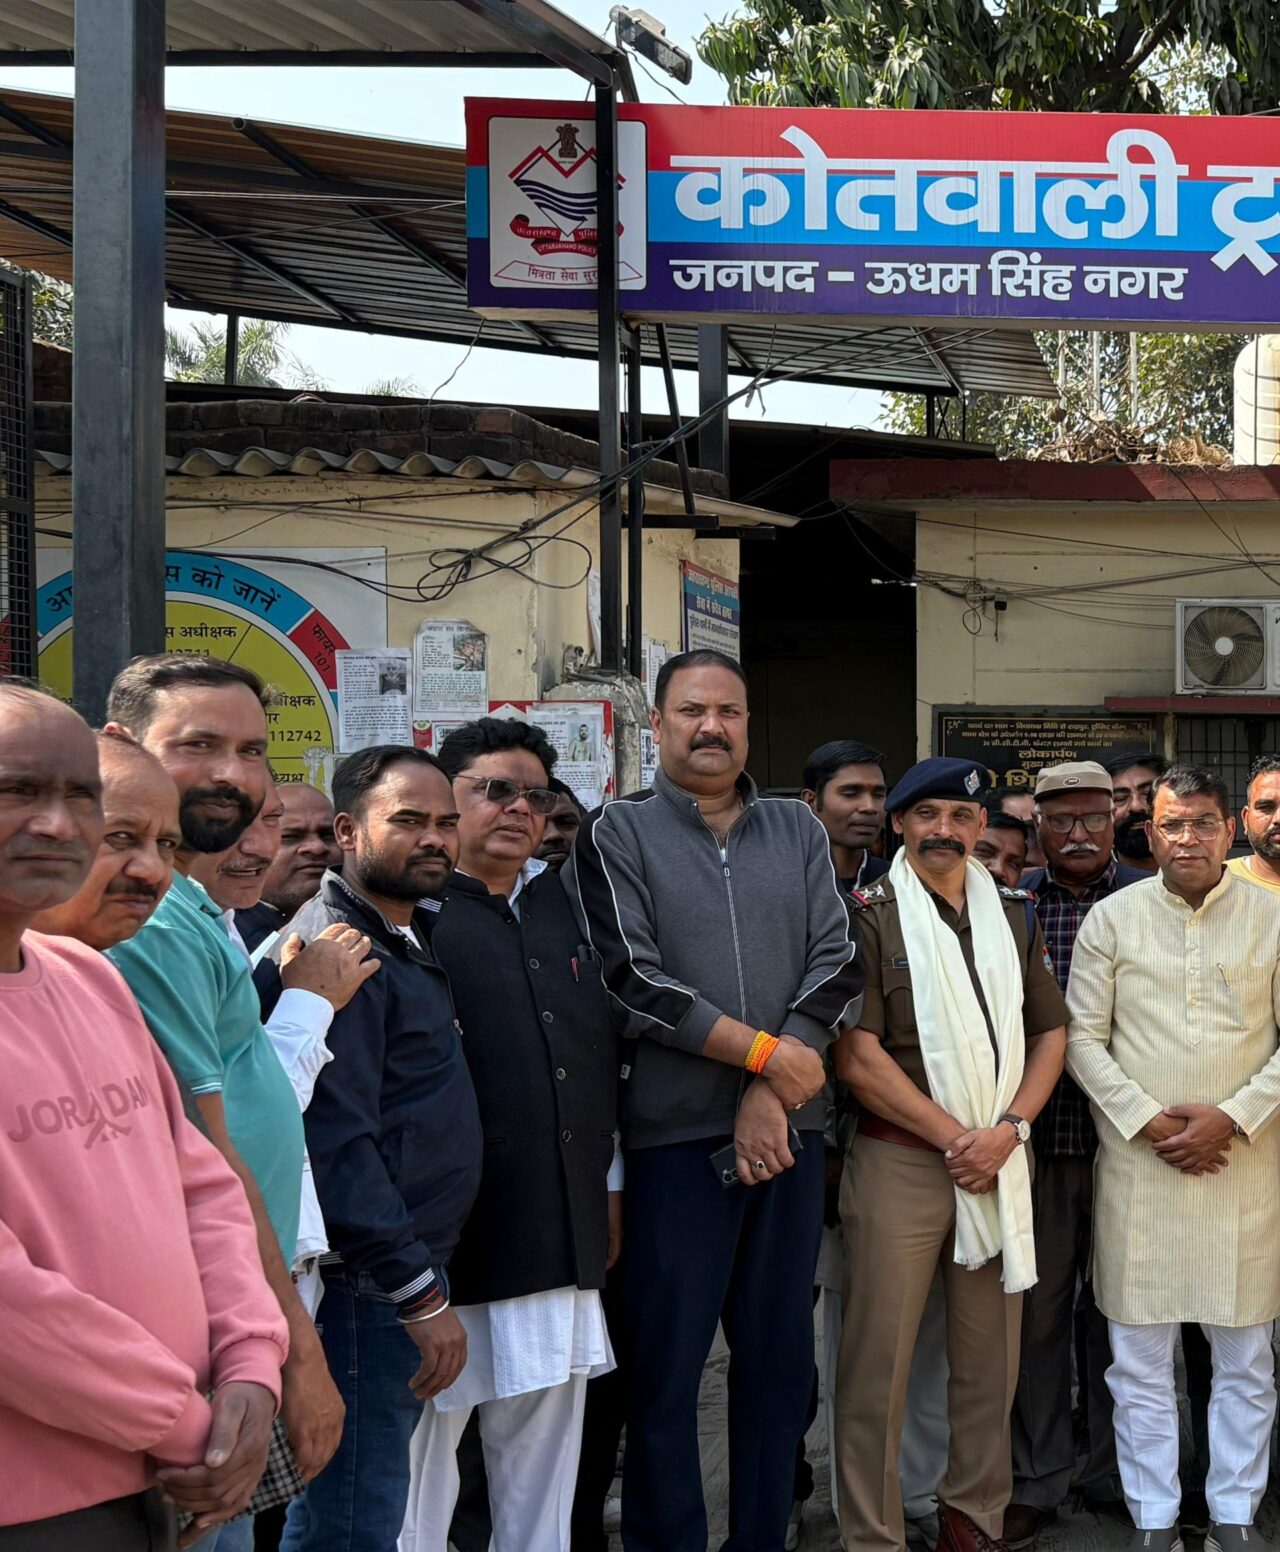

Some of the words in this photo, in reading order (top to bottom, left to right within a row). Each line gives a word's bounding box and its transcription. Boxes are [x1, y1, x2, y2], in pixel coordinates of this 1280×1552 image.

[670, 125, 1189, 240] कोतवाली
[561, 269, 577, 281] सेवा
[583, 269, 598, 285] सुर
[670, 260, 818, 293] जनपद
[865, 261, 980, 296] ऊधम
[990, 250, 1073, 301] सिंह
[1083, 265, 1190, 300] नगर
[191, 565, 226, 591] को
[233, 576, 282, 613] जानें
[179, 622, 237, 640] अधीक्षक
[311, 621, 338, 655] फायर
[314, 651, 331, 672] 101
[1018, 748, 1077, 758] लोकार्पण
